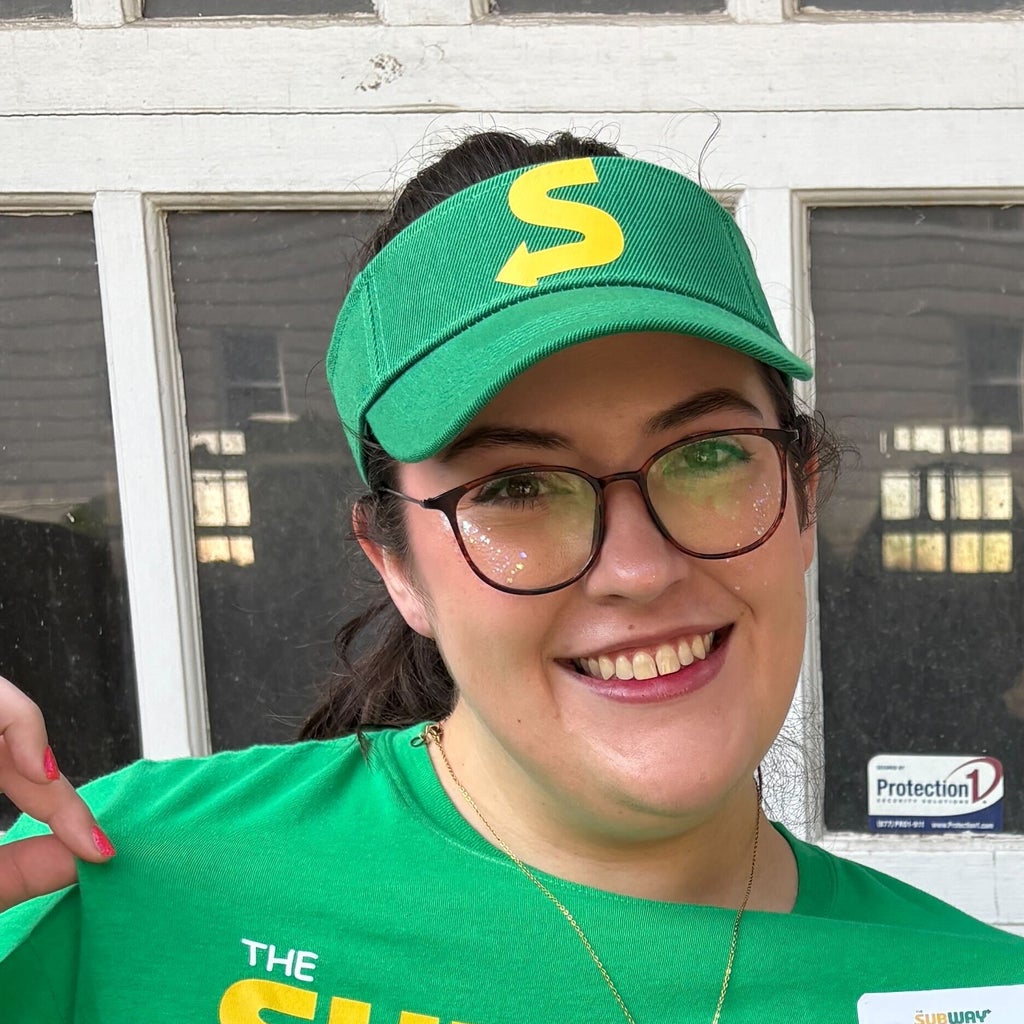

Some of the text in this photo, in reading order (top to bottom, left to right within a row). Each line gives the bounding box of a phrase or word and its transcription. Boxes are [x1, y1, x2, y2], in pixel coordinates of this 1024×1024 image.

[495, 157, 625, 288] S
[876, 779, 969, 797] Protection
[241, 938, 319, 983] THE
